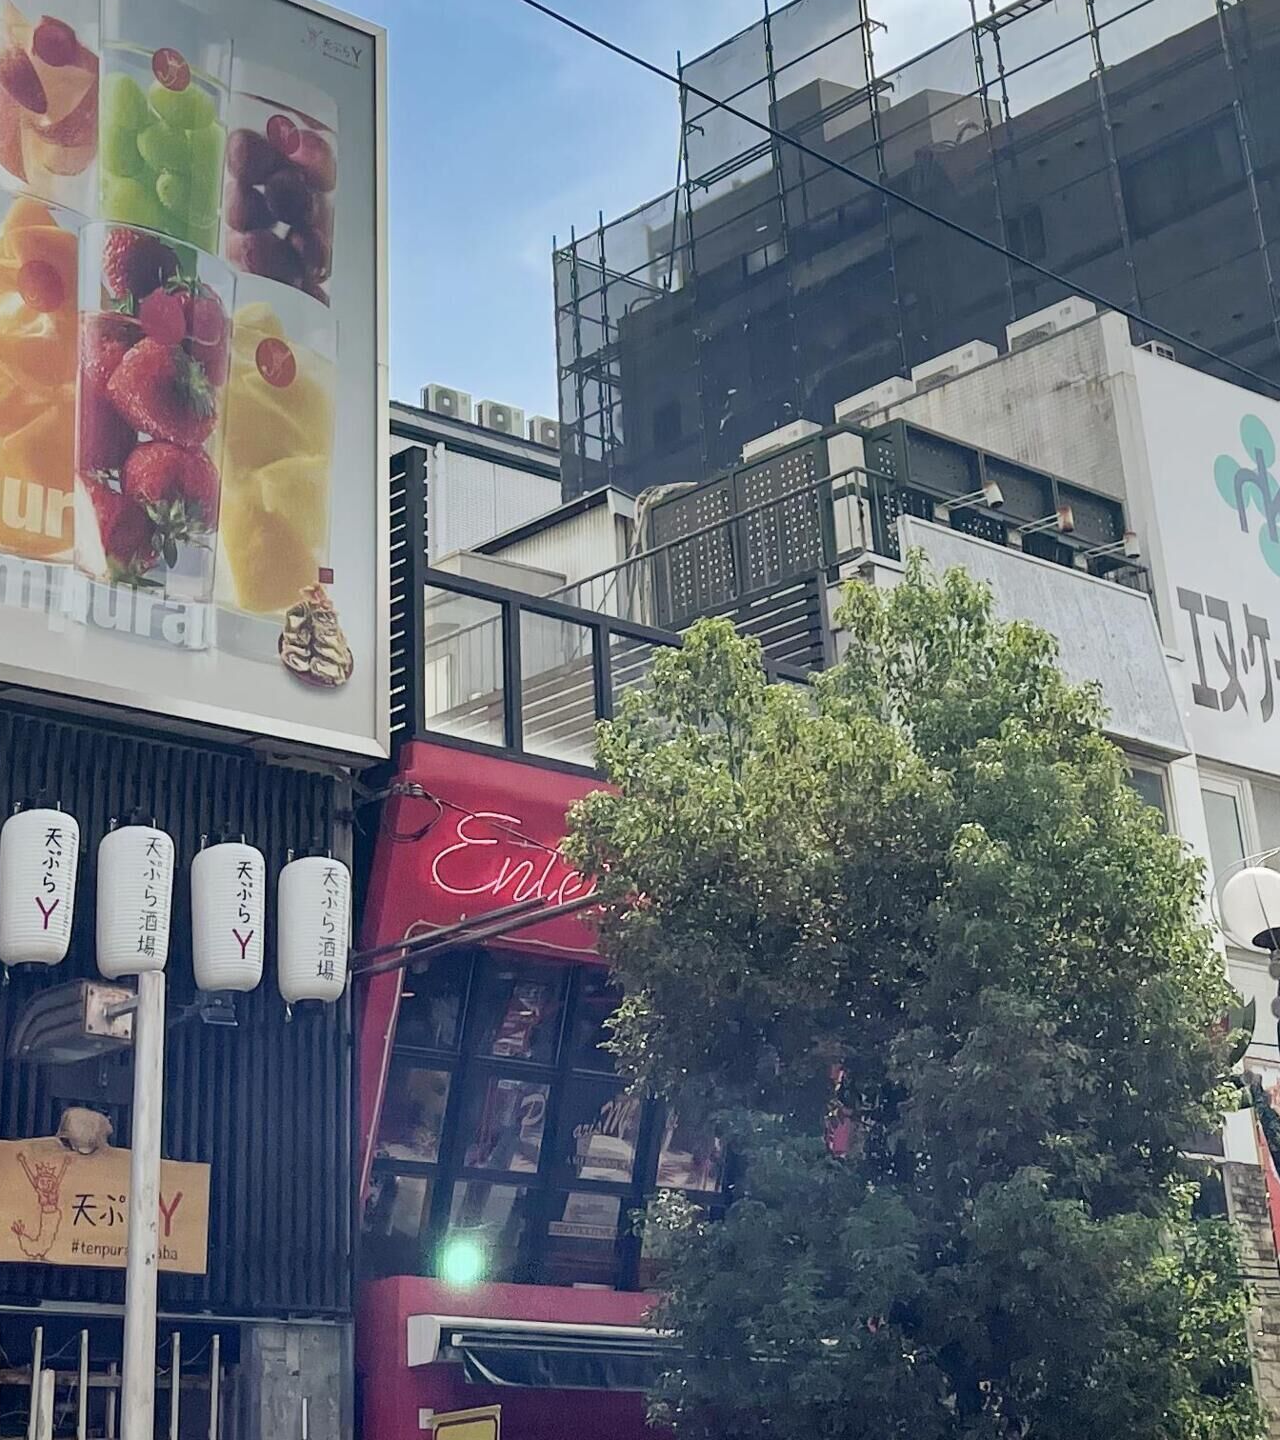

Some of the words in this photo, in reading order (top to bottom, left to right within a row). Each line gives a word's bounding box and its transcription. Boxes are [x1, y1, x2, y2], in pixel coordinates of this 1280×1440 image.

[137, 836, 163, 958] 天ぷら酒場
[431, 811, 600, 907] Ente
[316, 867, 339, 982] 天ぷら酒場
[72, 1192, 183, 1237] 天ぷY
